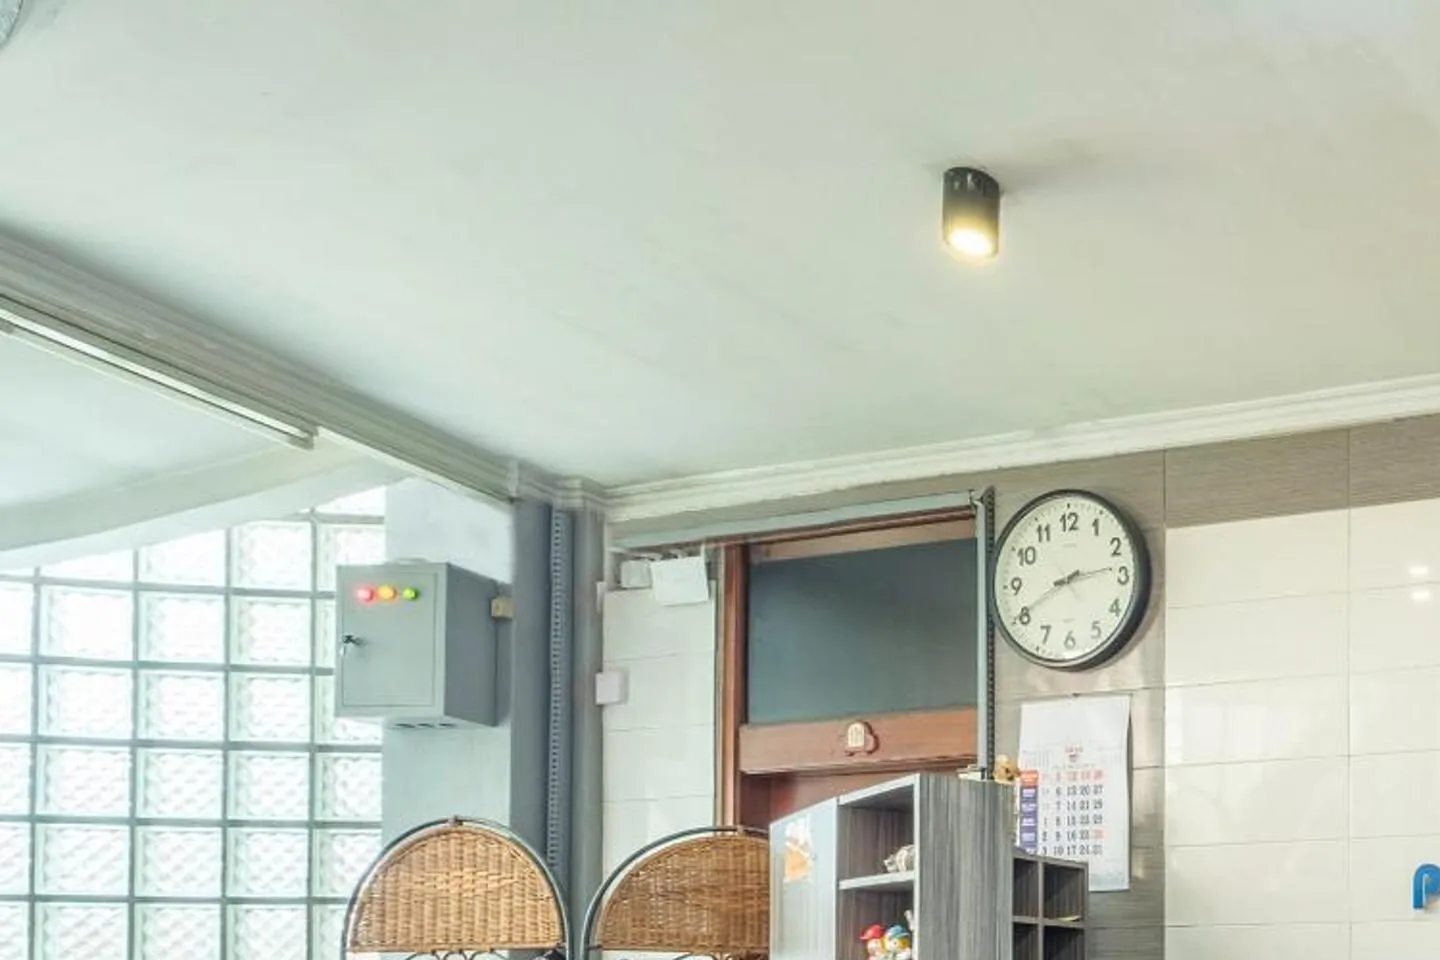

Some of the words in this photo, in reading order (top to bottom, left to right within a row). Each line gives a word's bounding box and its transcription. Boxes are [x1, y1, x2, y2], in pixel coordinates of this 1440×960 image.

[1060, 512, 1079, 532] 12
[1092, 519, 1099, 536] 1
[1037, 524, 1050, 542] 11
[1017, 546, 1036, 566] 10
[1110, 537, 1122, 556] 2
[1117, 566, 1129, 585] 3
[1011, 577, 1023, 595] 9
[1019, 606, 1031, 625] 8
[1109, 598, 1121, 617] 4
[1040, 625, 1051, 644] 7
[1091, 621, 1101, 639] 5
[1064, 631, 1076, 649] 6
